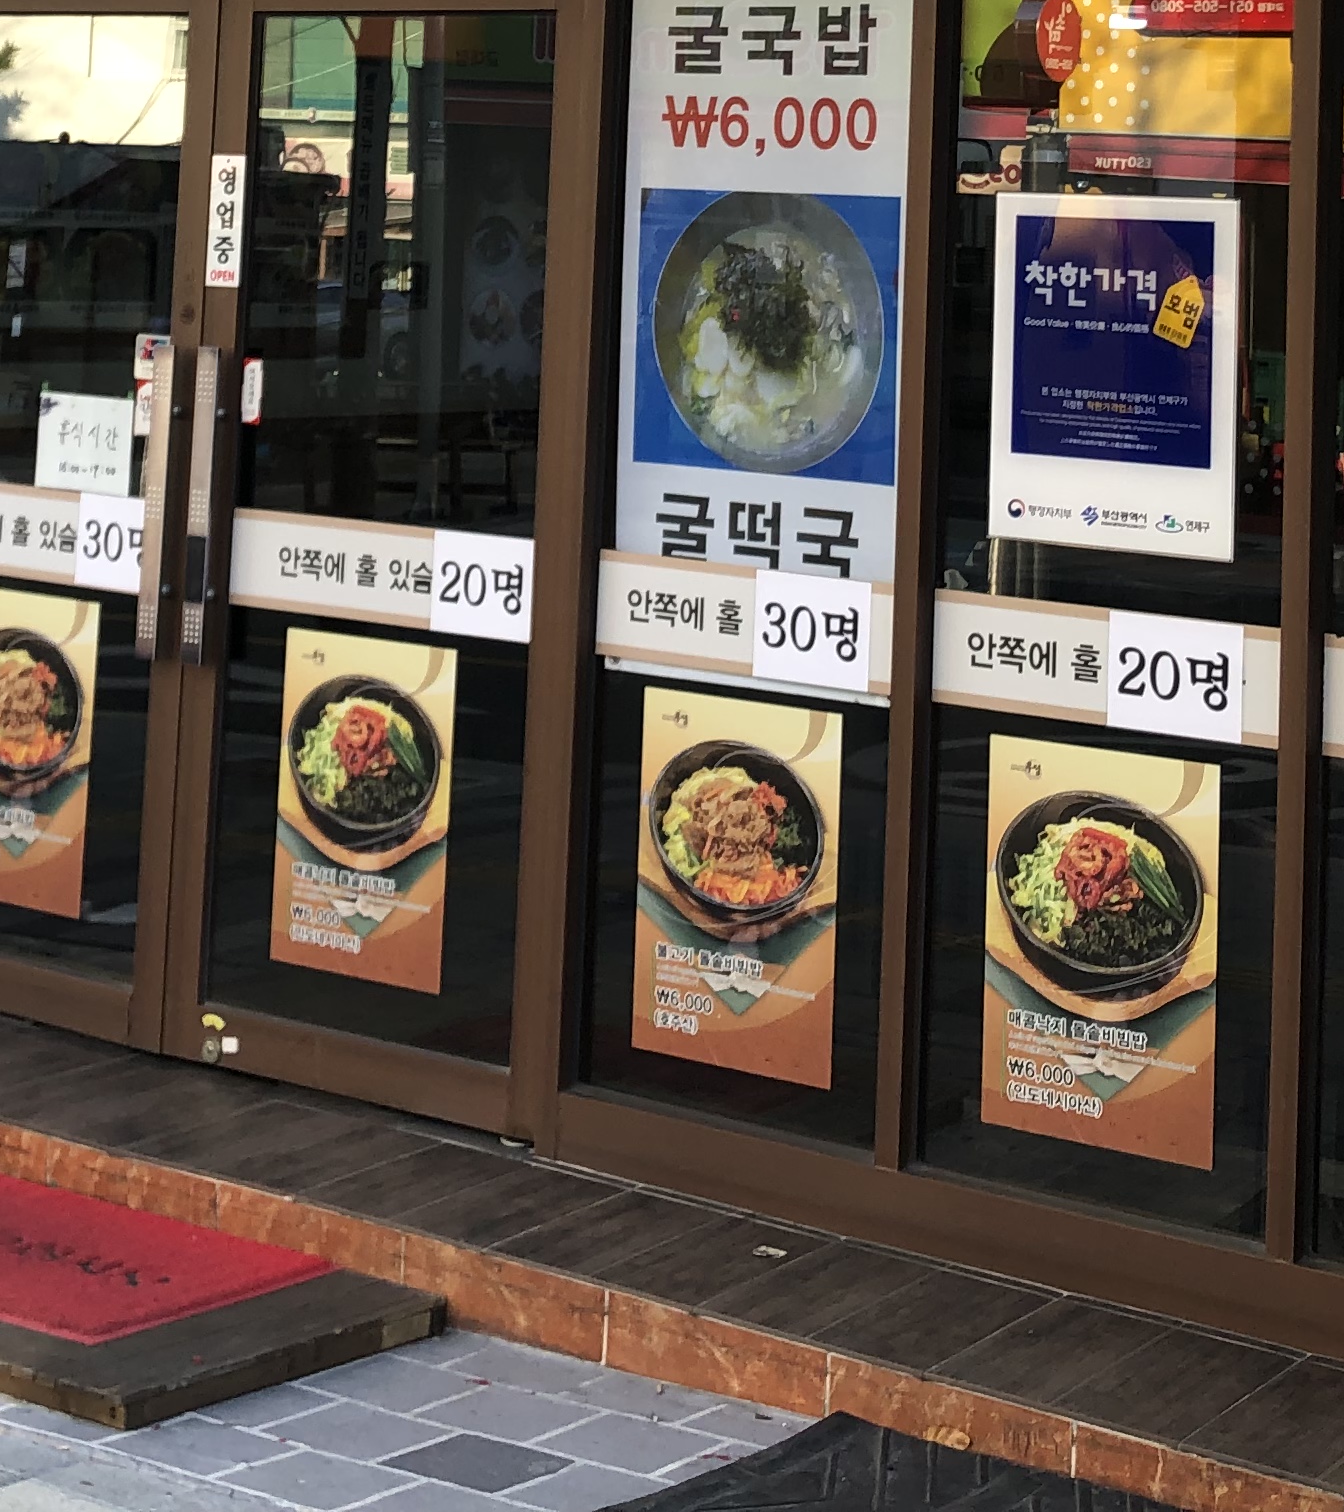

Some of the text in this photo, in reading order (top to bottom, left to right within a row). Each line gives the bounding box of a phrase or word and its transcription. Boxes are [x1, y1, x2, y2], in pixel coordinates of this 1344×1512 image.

[668, 4, 877, 76] 굴국밥
[662, 95, 877, 157] ₩6,000
[213, 166, 236, 264] 영업중
[210, 270, 234, 282] OPEN
[1025, 260, 1157, 311] 착한가격
[11, 516, 30, 547] 홀
[656, 492, 859, 578] 굴떡국
[278, 546, 346, 584] 안쪽에
[355, 554, 378, 587] 홀
[439, 561, 523, 615] 20명
[627, 590, 744, 636] 안쪽에 홀
[762, 602, 859, 663] 30명
[967, 631, 1102, 684] 안쪽에 홀
[1117, 646, 1230, 712] 20명
[655, 986, 713, 1015] ₩6,000
[1007, 1008, 1147, 1052] 매콤낙지 돌솥비빔밥
[1008, 1056, 1074, 1088] ₩6,000
[1006, 1081, 1103, 1119] (인도네시아산)
